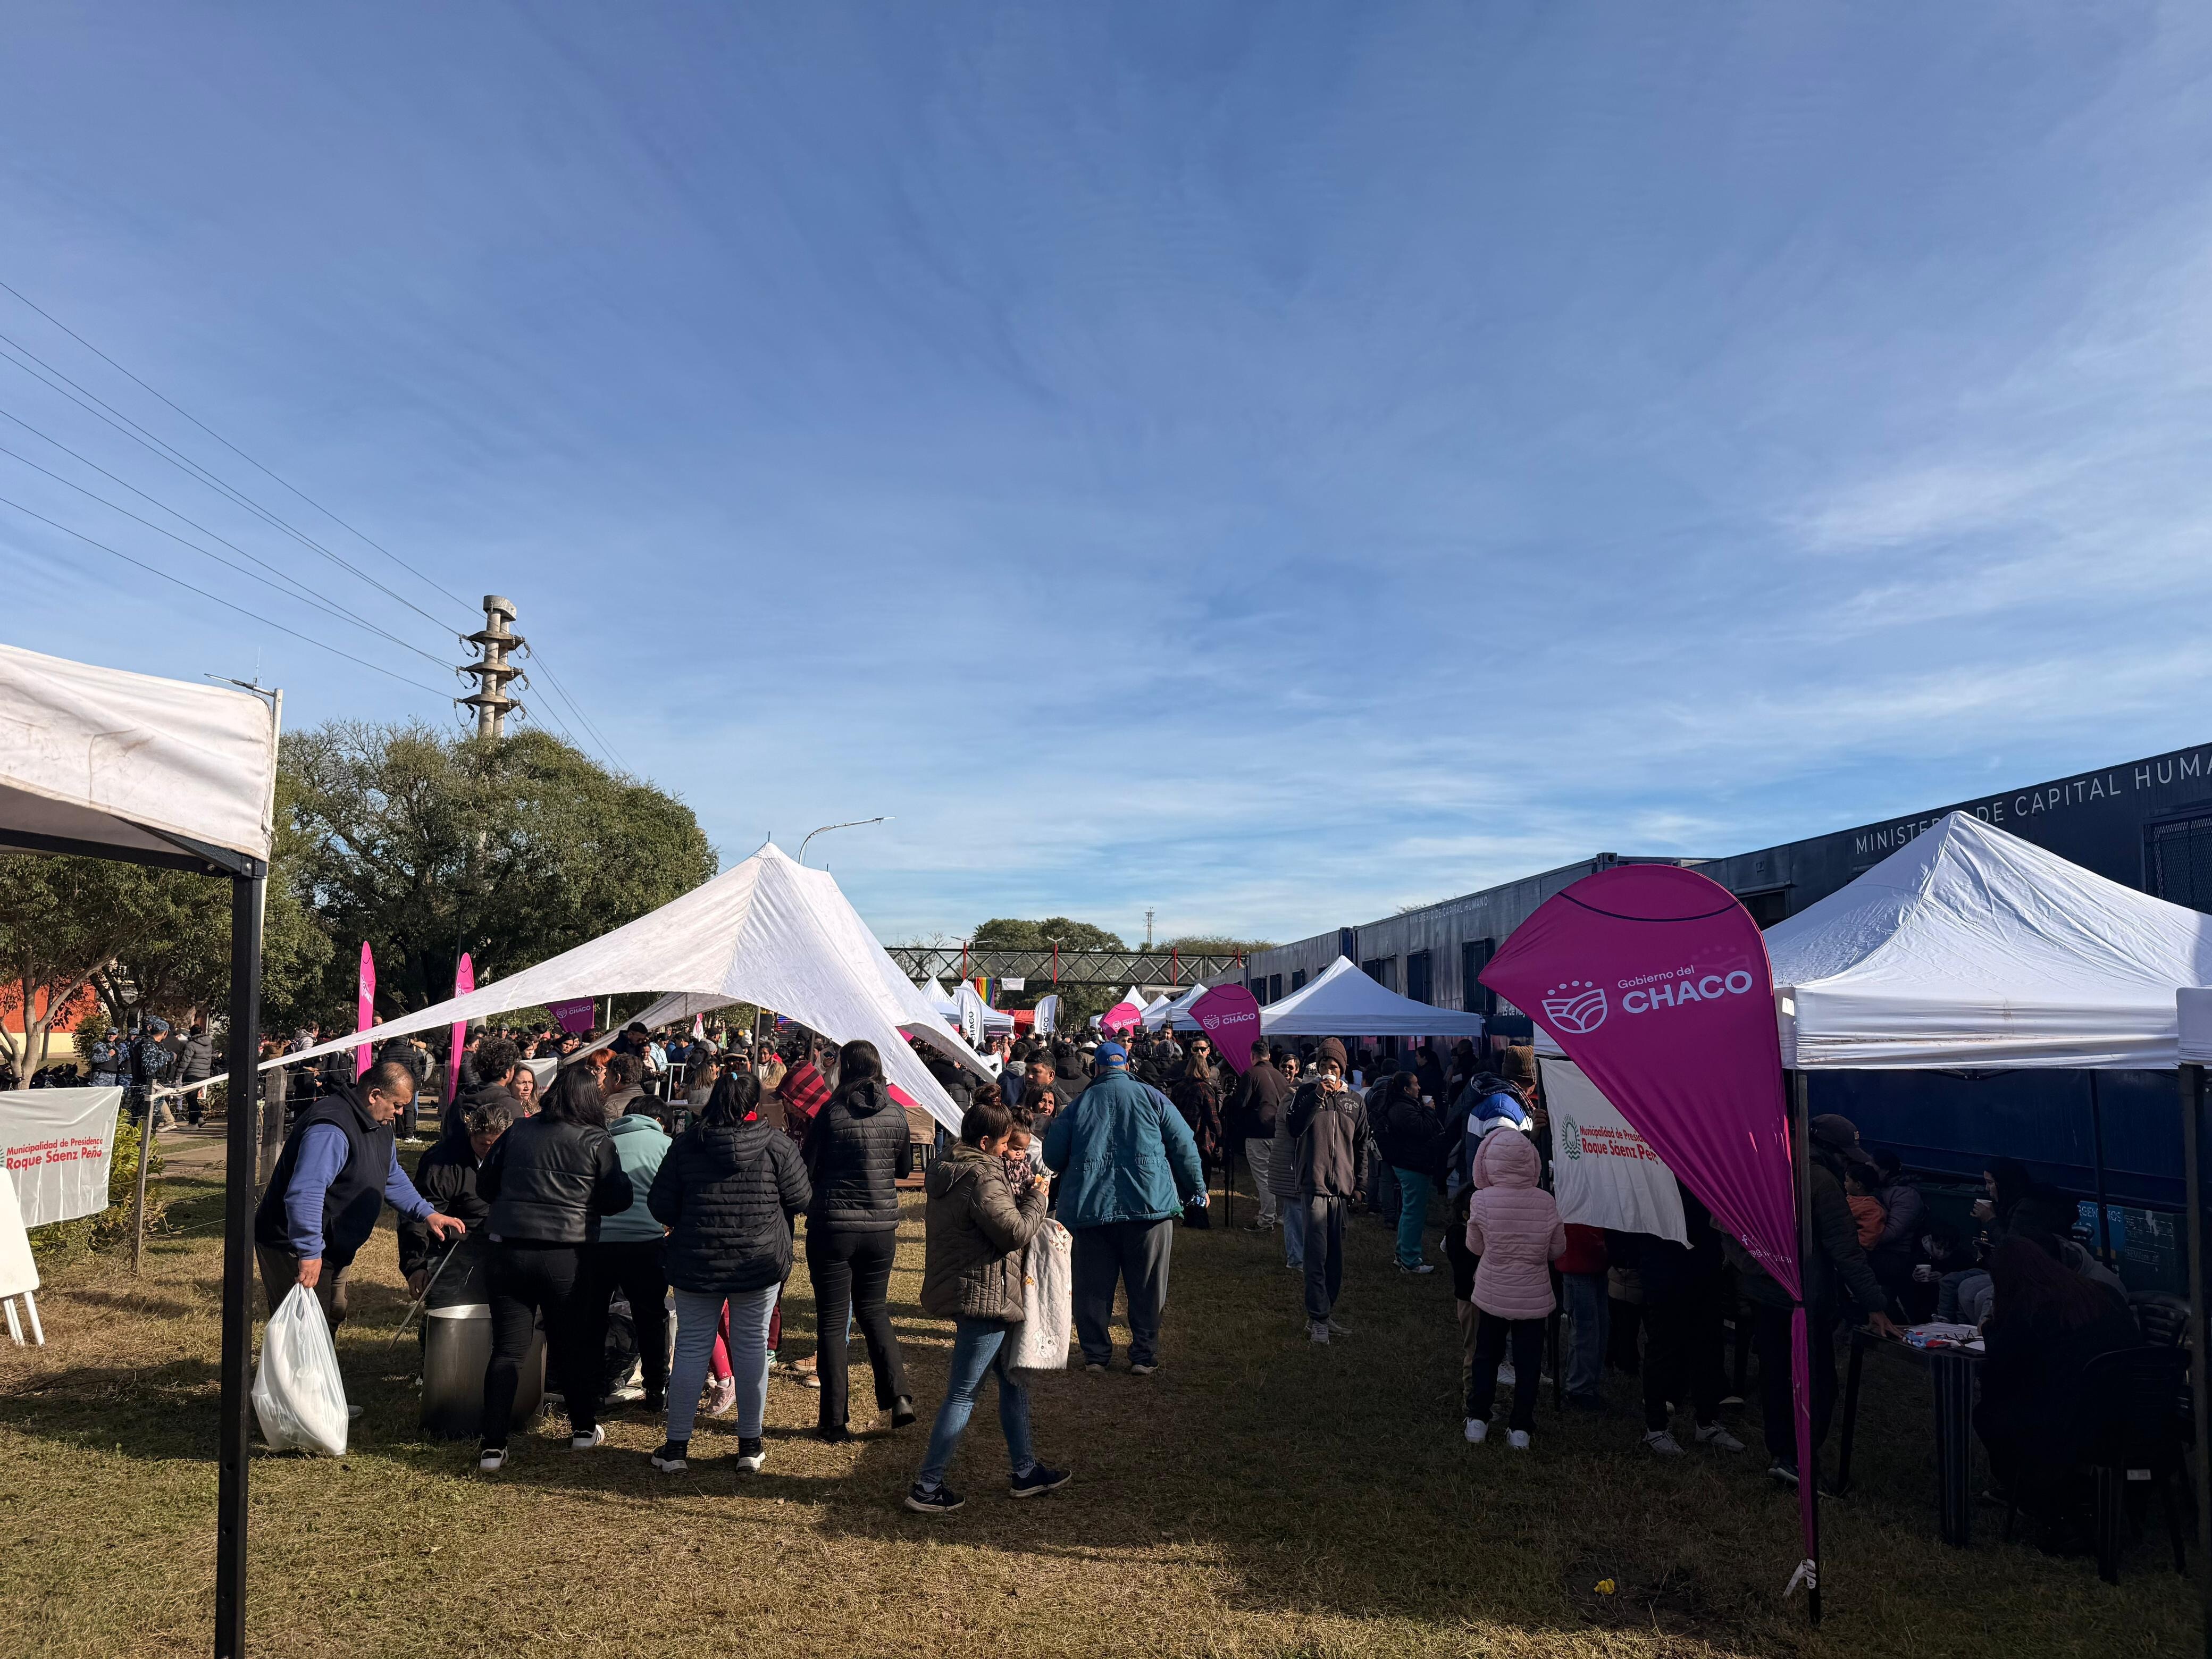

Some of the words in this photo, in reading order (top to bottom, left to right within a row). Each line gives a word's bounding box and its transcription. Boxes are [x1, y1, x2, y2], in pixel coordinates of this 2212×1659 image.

[1976, 801, 2004, 823] DE
[2015, 774, 2122, 817] CAPITAL
[1435, 908, 1442, 919] DE
[1443, 904, 1463, 917] CAPITAL
[1464, 895, 1488, 911] HUMANO
[1618, 970, 1674, 989] Gobierno
[1676, 965, 1695, 976] del
[1622, 970, 1753, 1013] CHACO
[569, 1006, 591, 1015] CHACO
[1223, 1013, 1255, 1024] CHACO
[1344, 1102, 1353, 1111] 68
[1580, 1125, 1615, 1139] Municipalidad
[1616, 1127, 1623, 1139] de
[6, 1139, 58, 1156] Municipalidad
[60, 1138, 69, 1147] de
[1581, 1138, 1608, 1158] Roque
[1608, 1139, 1638, 1159] Sáenz
[6, 1155, 43, 1171] Roque
[46, 1149, 78, 1163] Sáenz
